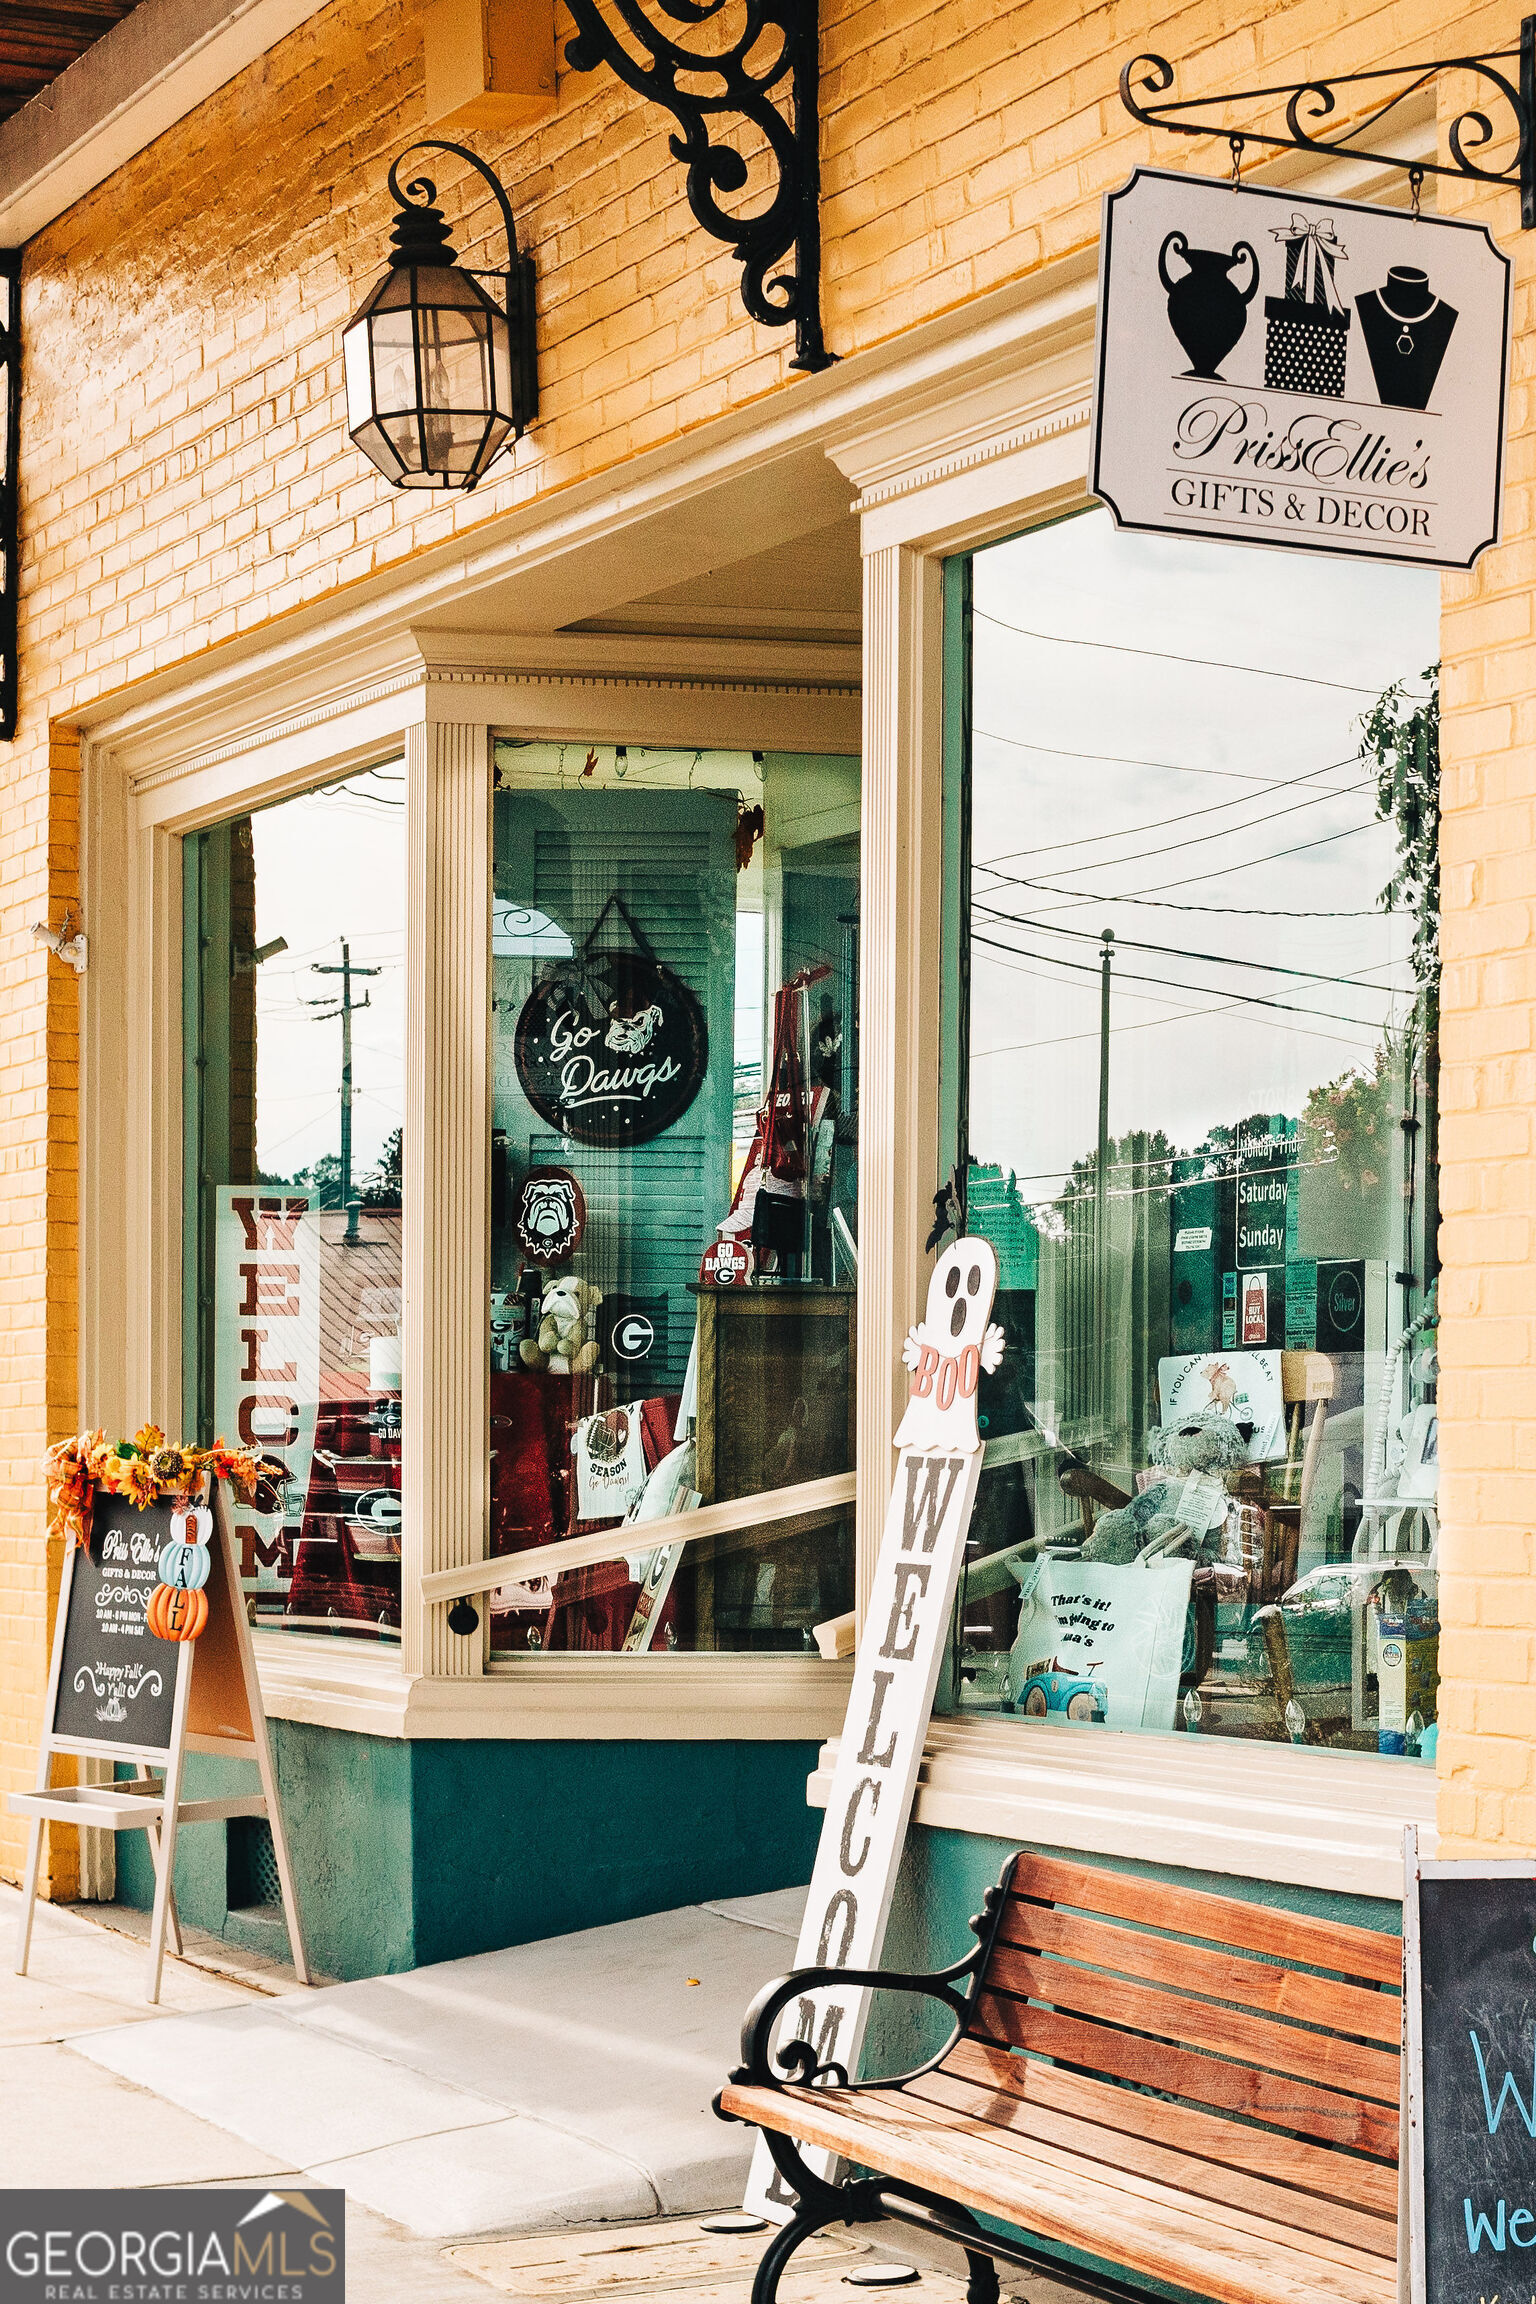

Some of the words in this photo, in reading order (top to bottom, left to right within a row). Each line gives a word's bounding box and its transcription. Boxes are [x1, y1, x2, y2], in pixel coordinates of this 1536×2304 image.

[1171, 478, 1274, 517] GIFTS
[1284, 497, 1306, 521] &
[1317, 497, 1433, 537] DECOR
[550, 1011, 600, 1060] Go
[560, 1055, 681, 1101] Dawgs
[1240, 1179, 1288, 1205] Saturday
[1239, 1223, 1284, 1250] Sunday
[717, 1243, 733, 1257] GO
[705, 1257, 745, 1271] DAWGS
[1248, 1305, 1261, 1315] BUY
[1334, 1292, 1356, 1313] Silver
[1246, 1315, 1264, 1325] LOCAL
[1259, 1360, 1269, 1371] BE
[909, 1343, 980, 1411] BOO
[1172, 1374, 1185, 1395] YOU
[1265, 1370, 1274, 1383] AT
[1169, 1398, 1178, 1406] IF
[590, 1458, 627, 1478] SEASON
[589, 1476, 599, 1491] Go
[102, 1568, 123, 1578] GIFTS
[124, 1568, 130, 1579] &
[131, 1569, 157, 1580] DECOR
[170, 1547, 193, 1632] FALL
[1051, 1594, 1092, 1607] That's
[1092, 1599, 1112, 1611] it!
[1101, 1622, 1115, 1631] to
[99, 1662, 124, 1681] Happy
